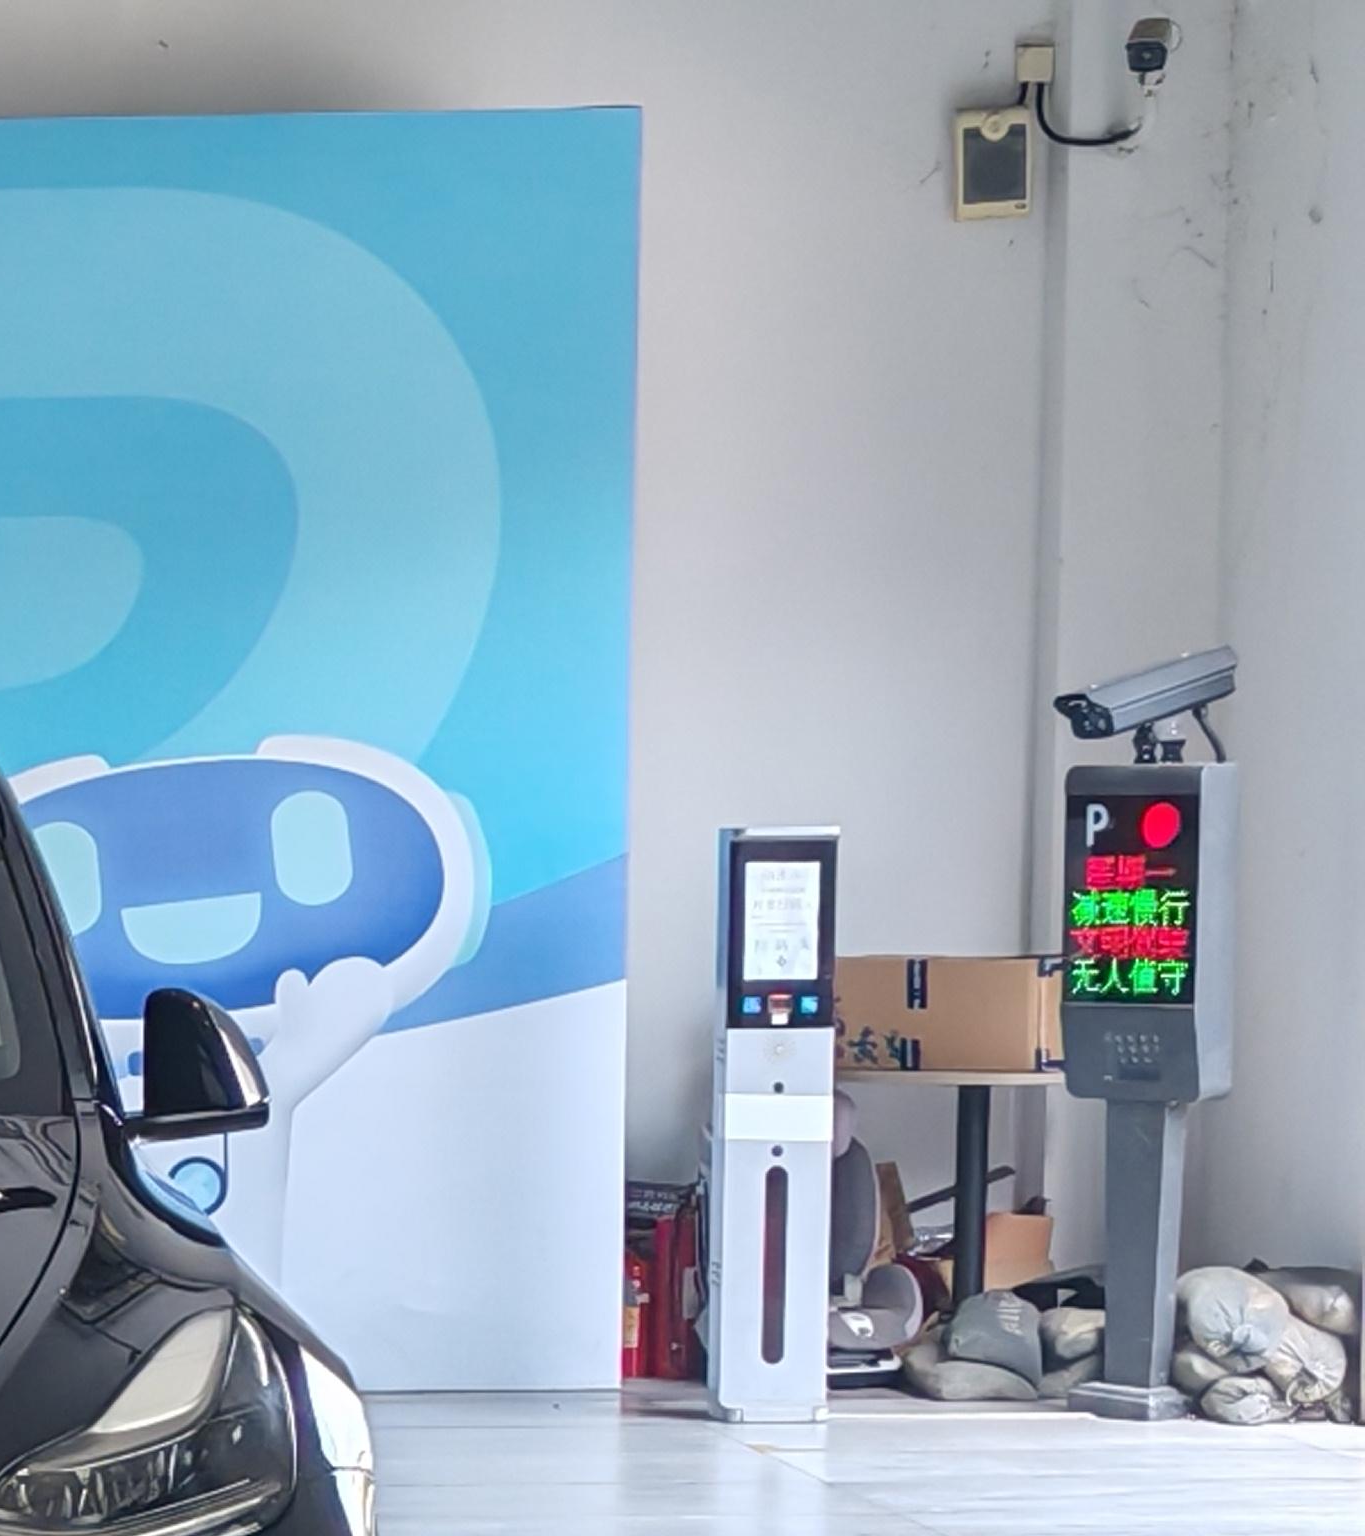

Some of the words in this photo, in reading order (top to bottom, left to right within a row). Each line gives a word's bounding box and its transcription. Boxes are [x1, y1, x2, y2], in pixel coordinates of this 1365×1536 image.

[1085, 803, 1110, 847] P
[1072, 888, 1190, 926] 减速慢行
[1072, 957, 1189, 996] 无人值守
